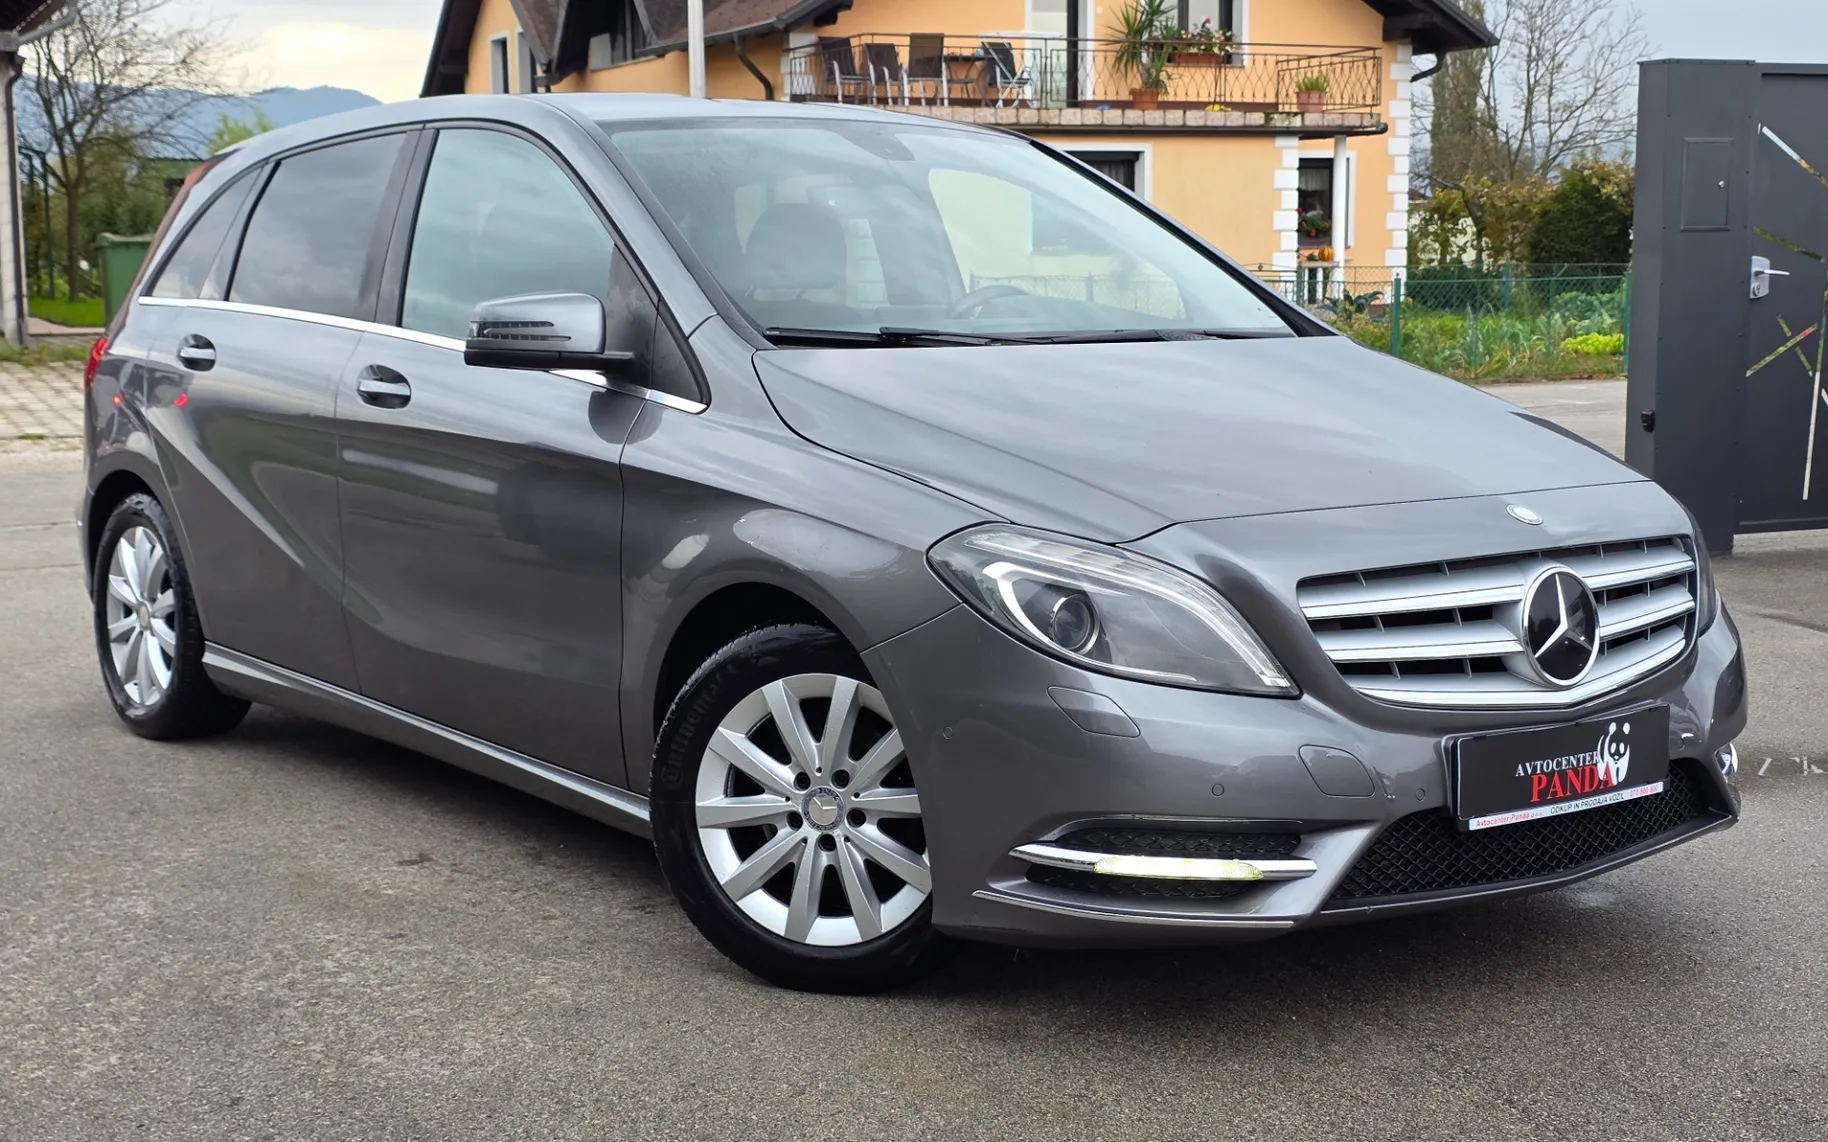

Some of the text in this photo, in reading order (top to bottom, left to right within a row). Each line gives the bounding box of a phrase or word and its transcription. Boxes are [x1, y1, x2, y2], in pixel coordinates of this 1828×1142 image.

[1515, 751, 1601, 776] AVTOCENTER
[1530, 762, 1615, 802] PANDA
[1550, 803, 1572, 814] ODKUP
[1580, 797, 1608, 808] PRODAJA
[1609, 793, 1624, 802] VOZIL
[1476, 815, 1509, 827] Avtocenter
[1511, 813, 1529, 822] Panda
